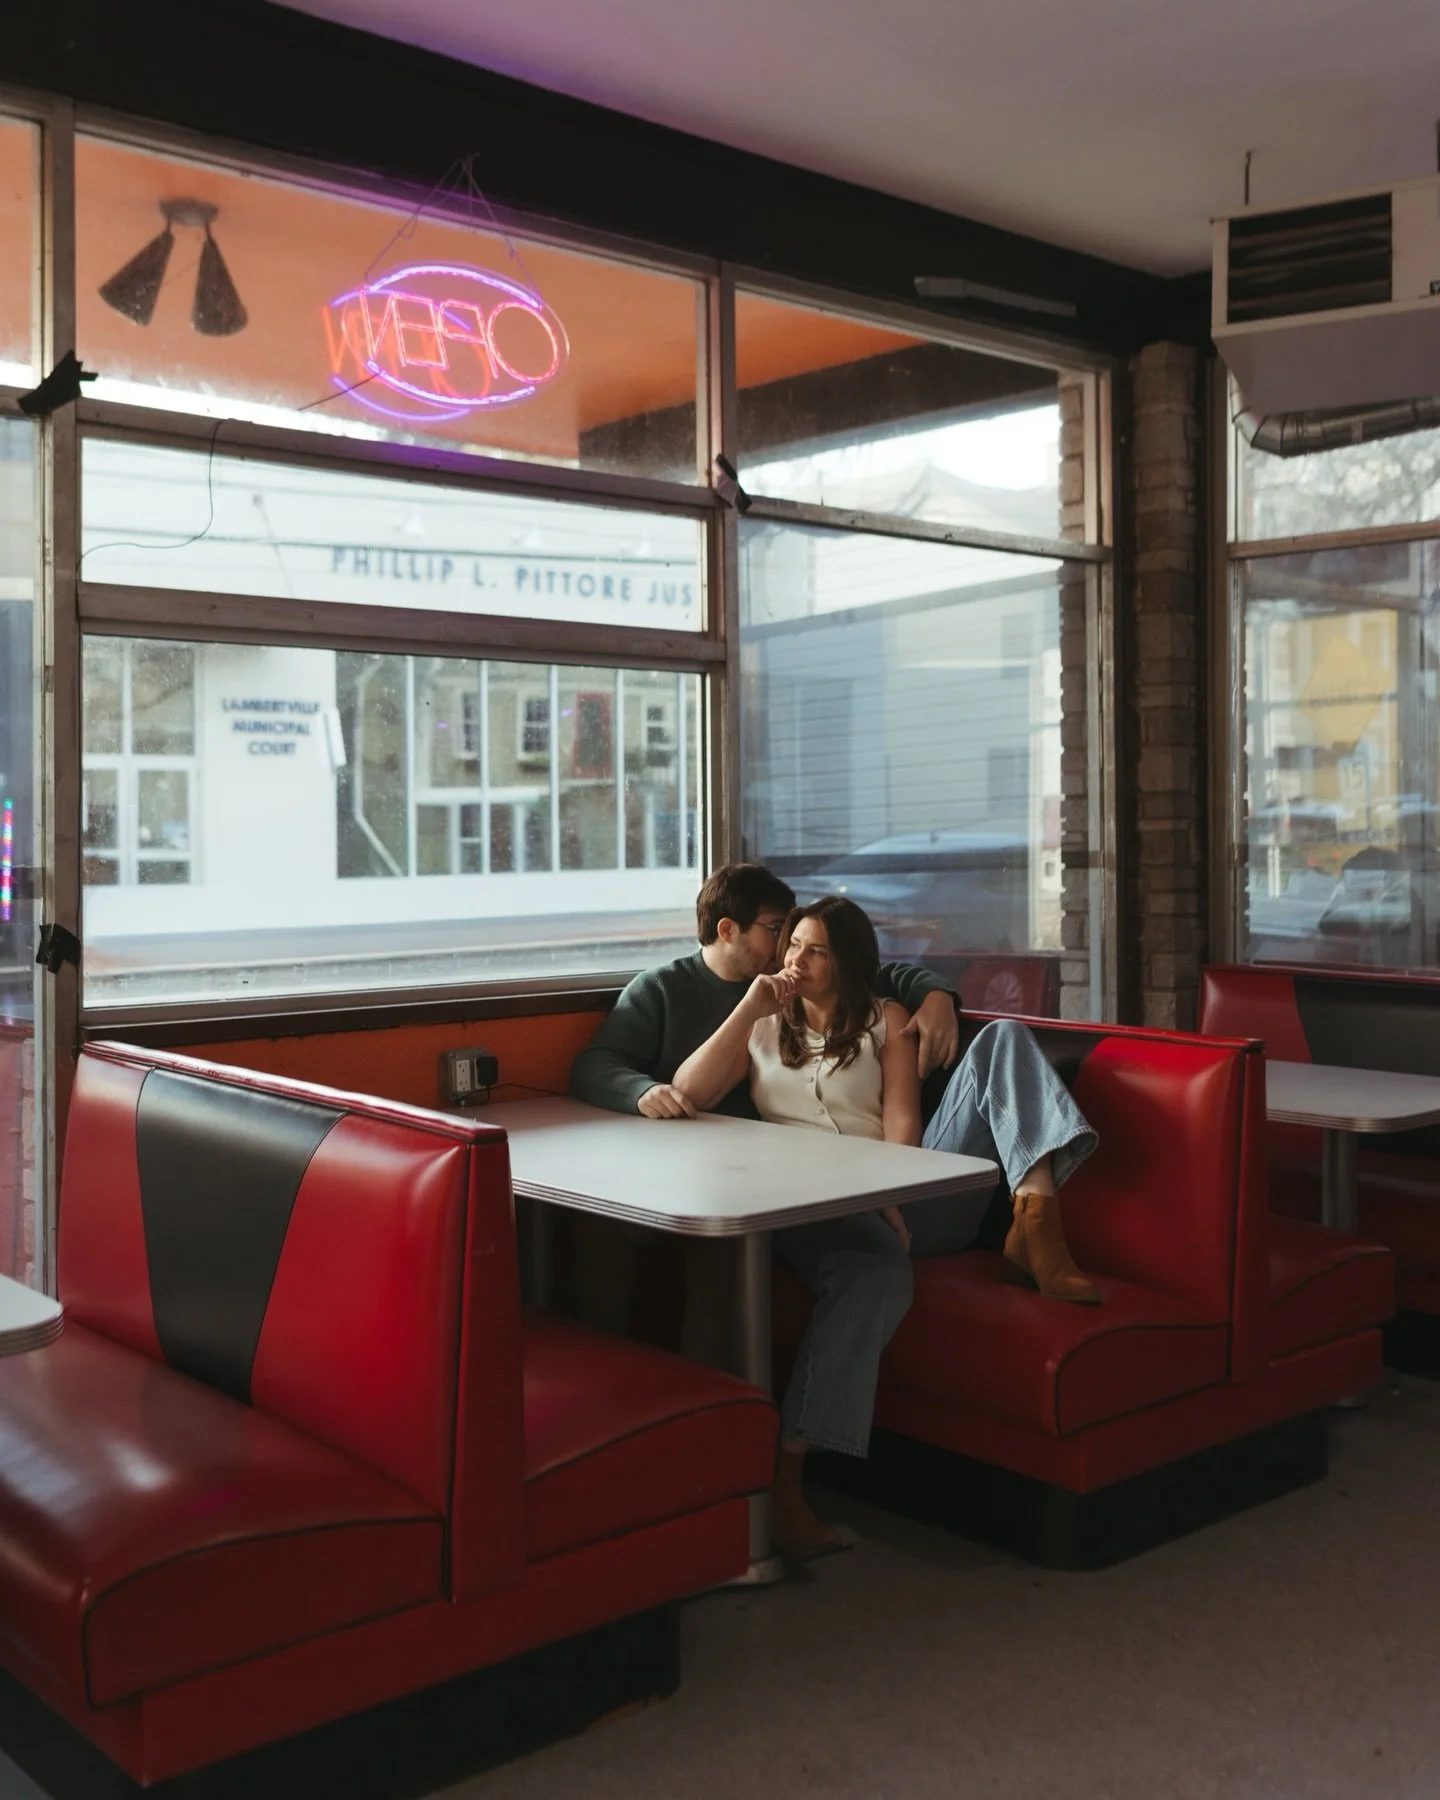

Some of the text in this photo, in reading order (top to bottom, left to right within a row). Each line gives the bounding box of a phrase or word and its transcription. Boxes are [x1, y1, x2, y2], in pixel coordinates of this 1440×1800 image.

[331, 545, 693, 607] PHILLIP L. PITTORE JUS
[221, 697, 319, 715] LAMBERTVILLE
[231, 719, 311, 736] MUNICIPAL
[247, 740, 297, 756] COURT
